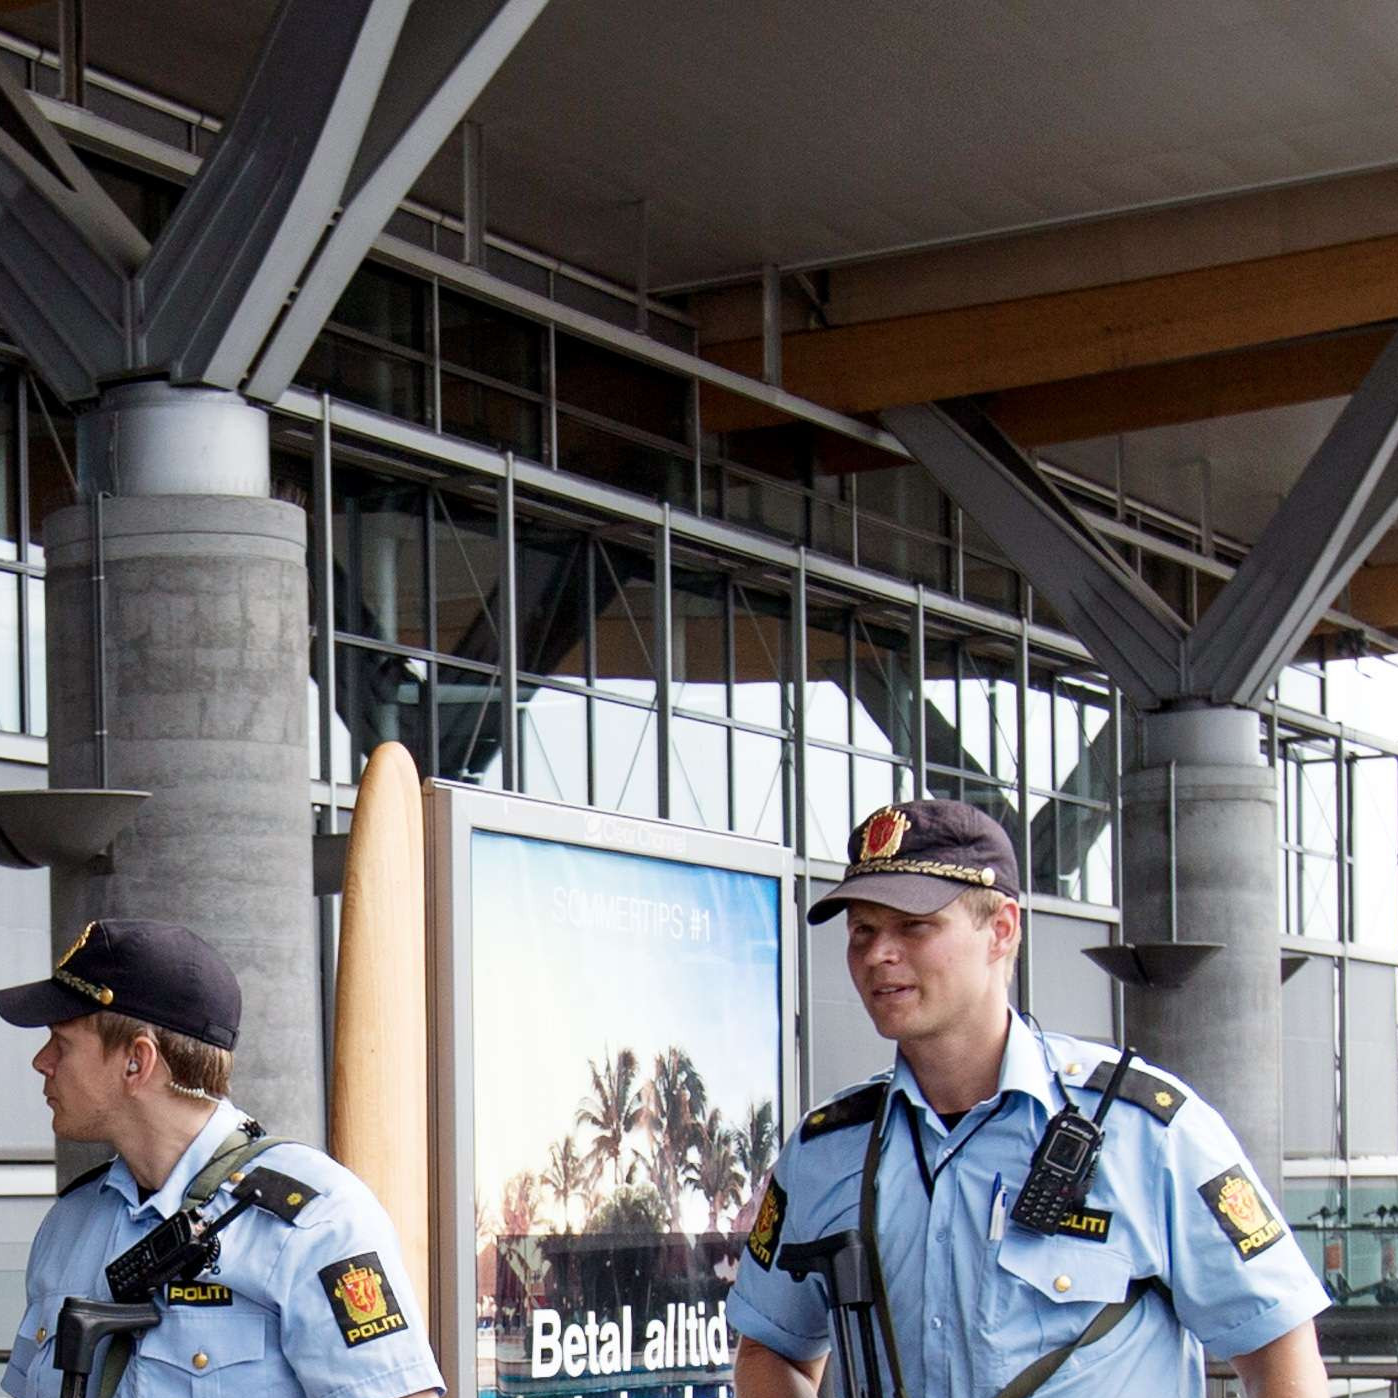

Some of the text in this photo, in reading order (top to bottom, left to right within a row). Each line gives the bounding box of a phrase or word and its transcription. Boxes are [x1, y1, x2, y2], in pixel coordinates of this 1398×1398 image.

[553, 886, 711, 943] SOMMERTIPS #1
[1238, 1220, 1284, 1254] POLITI
[170, 1285, 229, 1301] POLITI
[347, 1313, 404, 1342] POLITI
[532, 1300, 730, 1378] Betal alltid
